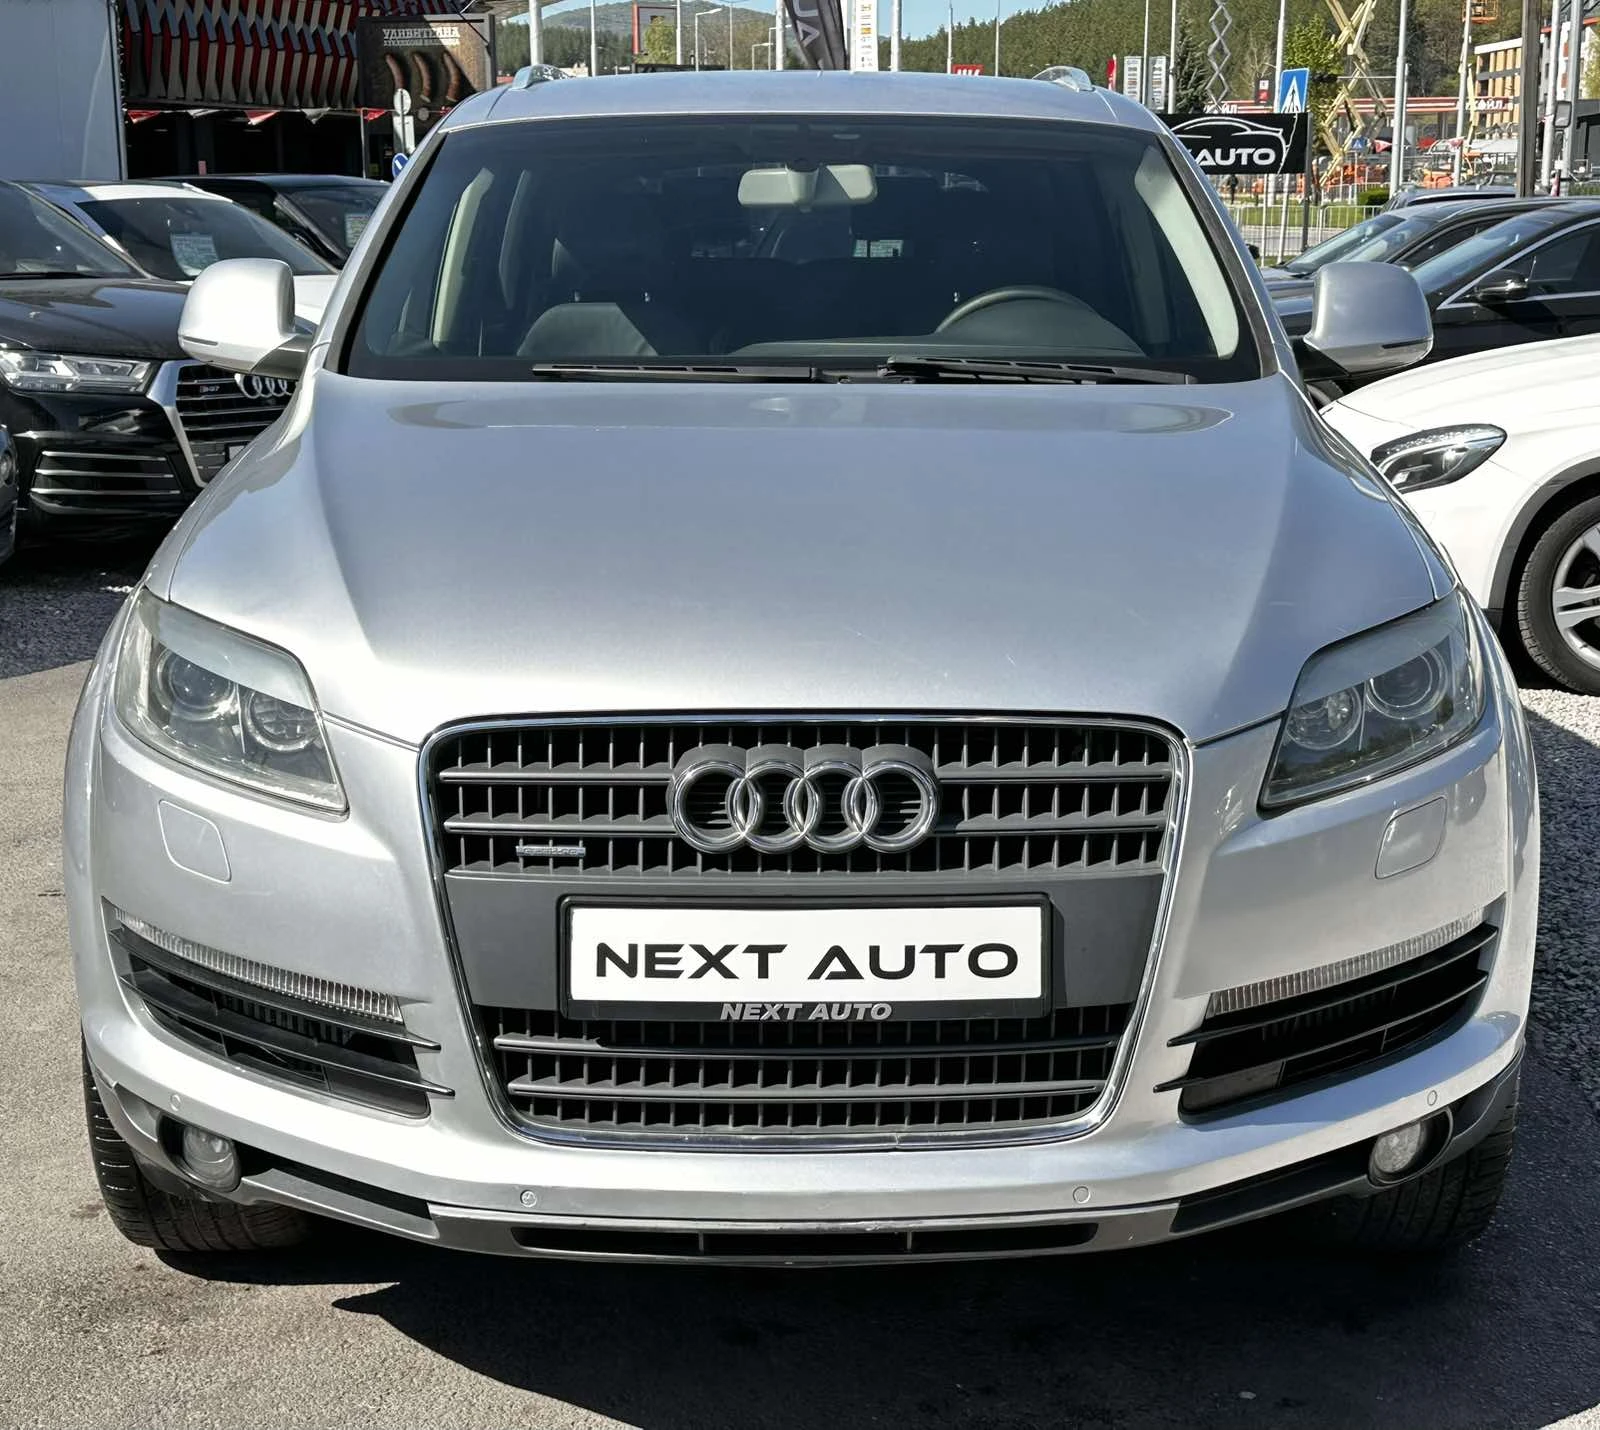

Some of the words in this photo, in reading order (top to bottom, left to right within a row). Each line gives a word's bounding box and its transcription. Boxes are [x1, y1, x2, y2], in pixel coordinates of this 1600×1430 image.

[1195, 148, 1276, 166] AUTO
[596, 942, 788, 980] NEXT
[807, 942, 1019, 980] AUTO
[720, 1003, 803, 1020] NEXT
[808, 1003, 892, 1020] AUTO
